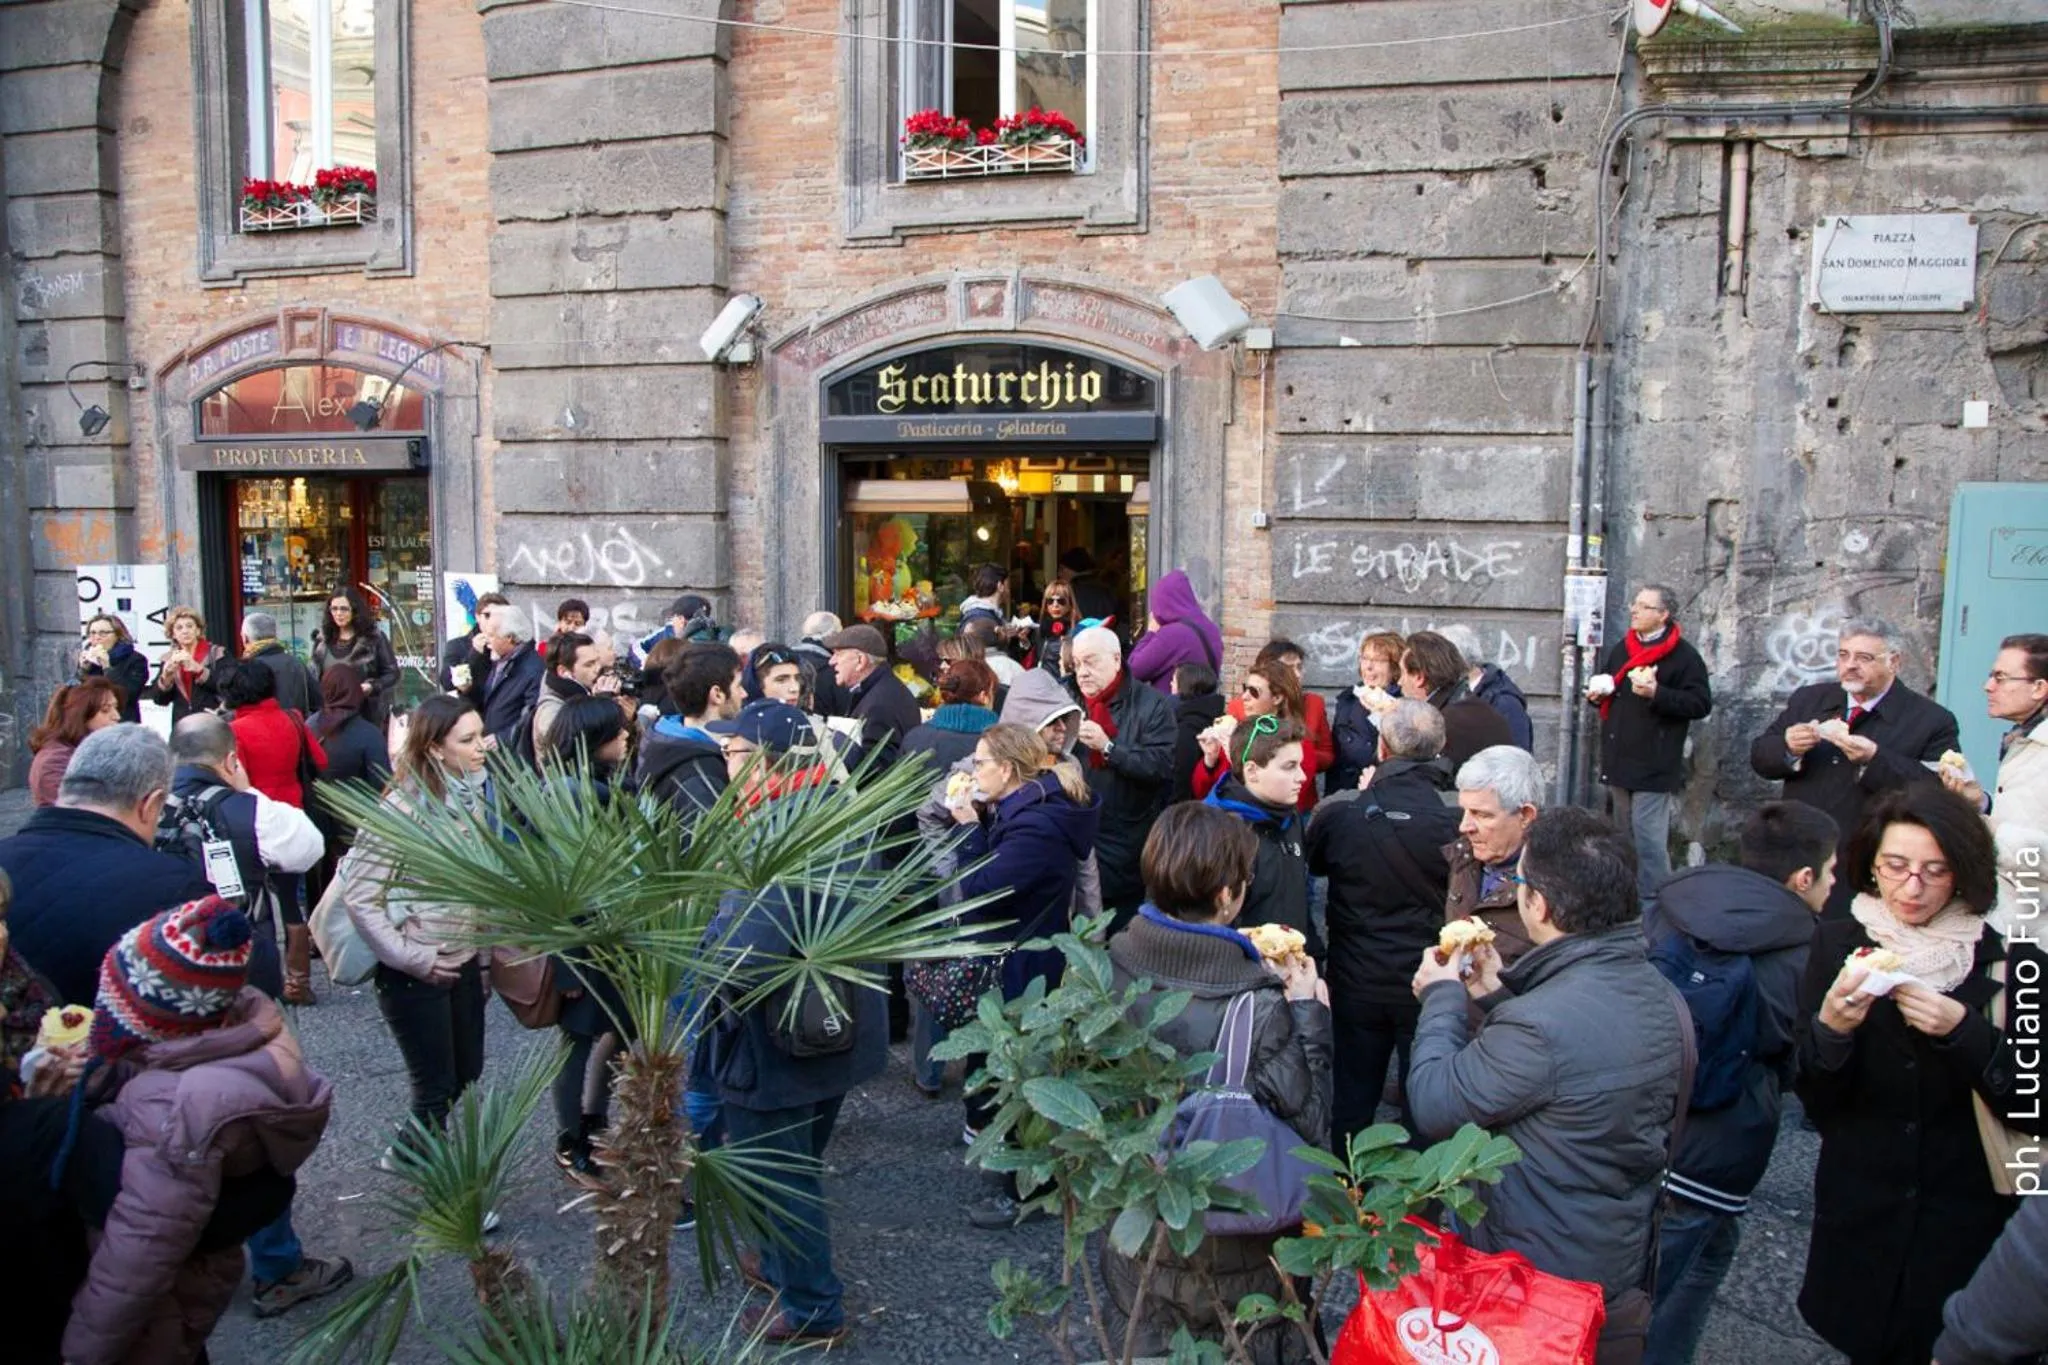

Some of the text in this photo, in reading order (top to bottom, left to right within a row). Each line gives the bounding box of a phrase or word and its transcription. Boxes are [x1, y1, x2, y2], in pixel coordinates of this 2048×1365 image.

[1873, 233, 1916, 243] PIAZZA
[1822, 256, 1969, 269] SAN DOMENICO MAGGIORE
[1887, 294, 1904, 302] SAN
[220, 331, 271, 368] POSTE
[271, 366, 348, 425] Alex
[877, 360, 1102, 414] Scaturchio
[897, 420, 984, 438] Pasticceria
[996, 419, 1067, 440] Gelateria
[215, 447, 368, 467] PROFUMERIA
[1292, 538, 1524, 594] LE STRADE
[1500, 628, 1537, 674] DI
[1407, 1318, 1489, 1365] OASI
